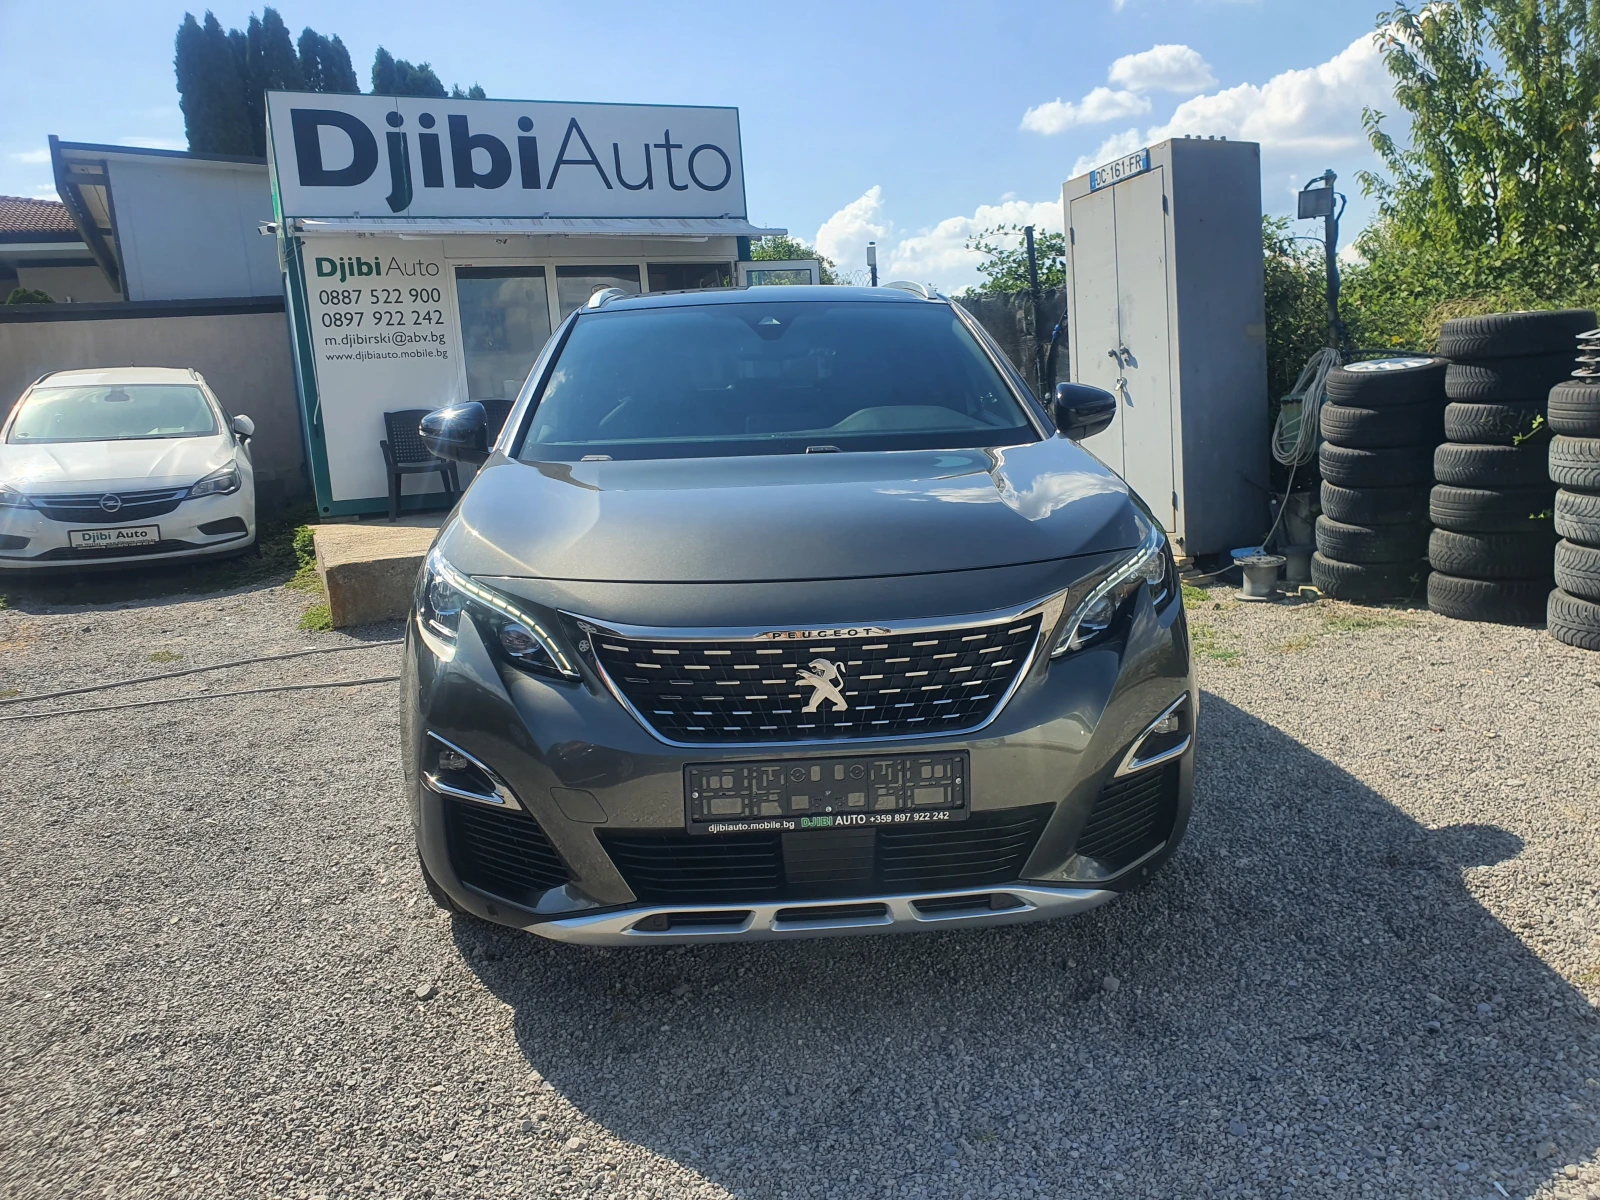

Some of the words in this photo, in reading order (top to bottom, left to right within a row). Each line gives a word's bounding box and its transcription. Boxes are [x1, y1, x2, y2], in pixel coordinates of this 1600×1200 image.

[315, 256, 382, 283] Djibi
[386, 256, 440, 277] Auto
[319, 289, 363, 305] 0887
[370, 288, 404, 304] 522
[409, 287, 441, 303] 900
[322, 312, 365, 328] 0897
[372, 311, 406, 326] 922
[411, 309, 445, 325] 242
[325, 331, 446, 348] m.djibirski@abv.bg
[325, 349, 449, 362] www.djibiauto.mobile.bg
[82, 532, 112, 543] Djibi
[116, 530, 148, 540] Auto
[772, 628, 873, 640] PEUGEOT
[708, 820, 795, 834] djibiauto.mobile.bg
[801, 816, 834, 828] DJIBI
[835, 814, 866, 826] AUTO
[870, 813, 892, 823] +359
[894, 813, 911, 822] 897
[913, 812, 930, 821] 922
[932, 811, 950, 820] 242
